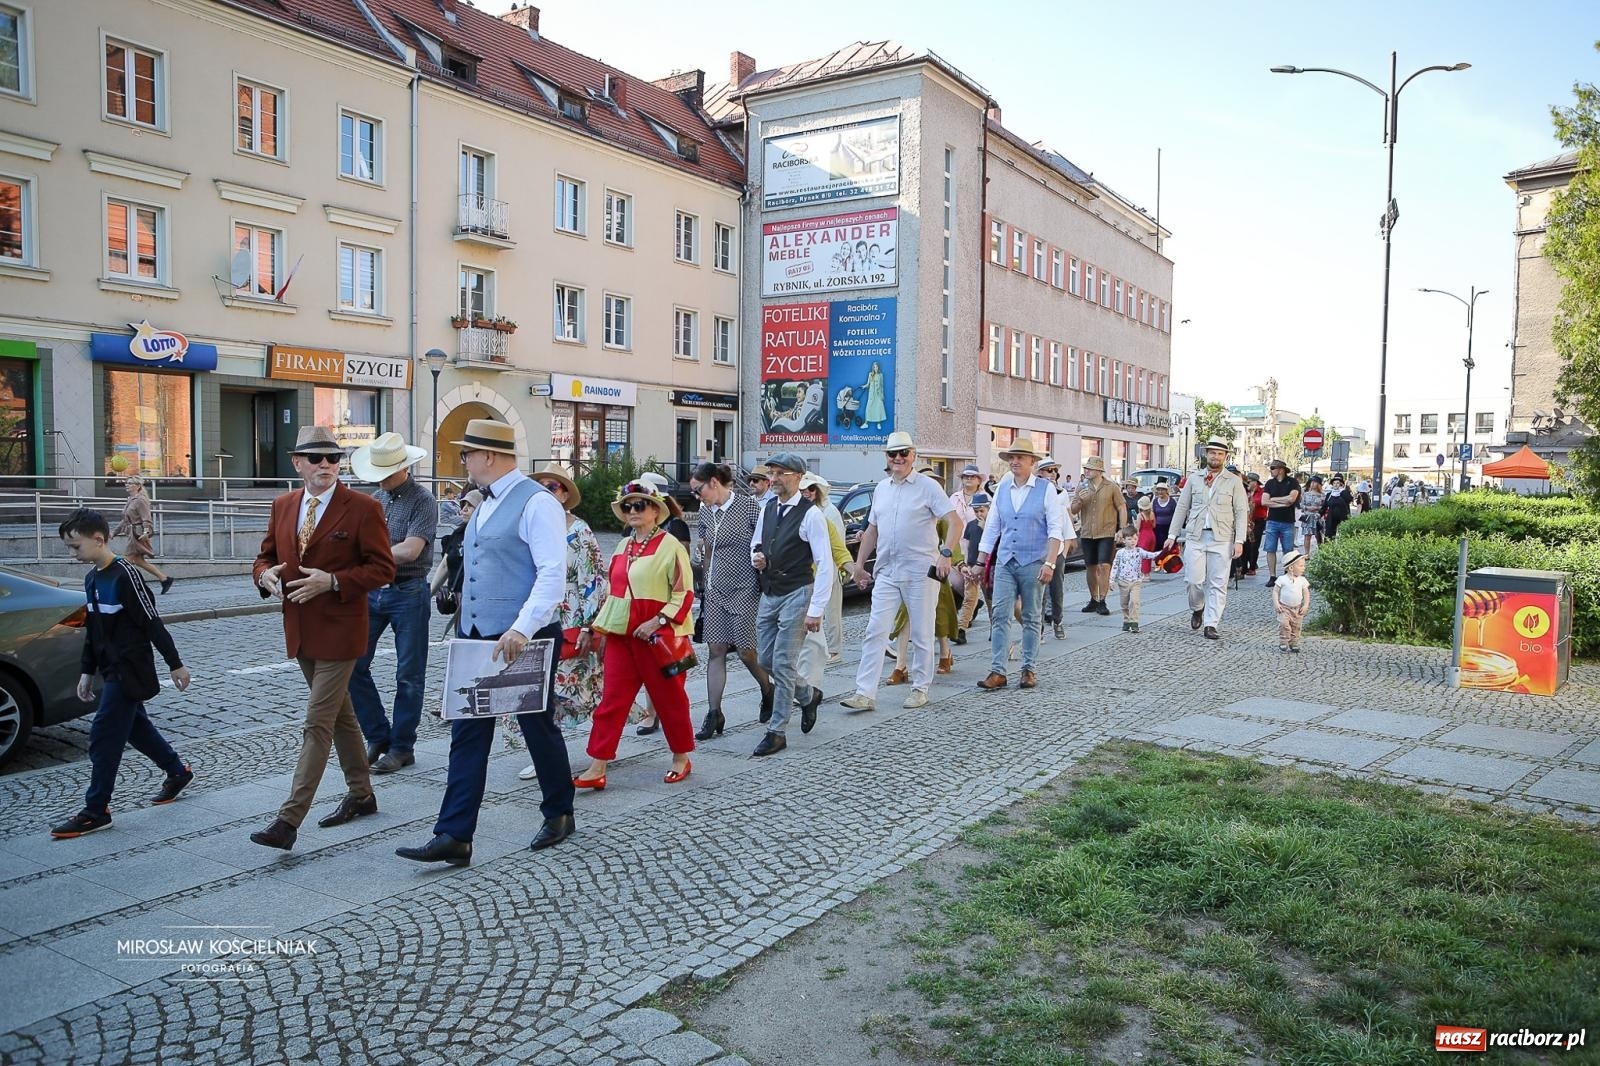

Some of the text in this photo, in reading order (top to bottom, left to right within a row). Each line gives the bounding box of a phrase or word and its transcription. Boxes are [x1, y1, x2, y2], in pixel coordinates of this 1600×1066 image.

[771, 224, 801, 232] Najlepsze
[802, 221, 818, 230] firmy
[826, 215, 864, 226] najlepszych
[864, 212, 888, 221] cenach
[769, 224, 890, 249] ALEXANDER
[769, 248, 810, 262] MEBLE
[773, 280, 811, 292] RYBNIK,
[814, 279, 824, 288] ul.
[870, 274, 885, 283] 192
[764, 306, 828, 323] FOTELIKI
[839, 314, 880, 323] Komunalna
[143, 338, 176, 352] LOTTO
[765, 330, 827, 349] RATUJĄ
[833, 338, 891, 347] SAMOCHODOWE
[276, 352, 343, 373] FIRANY
[346, 360, 403, 378] SZYCIE
[766, 353, 822, 373] ŻYCIE!
[584, 385, 621, 397] RAINBOW
[1520, 640, 1542, 653] bio
